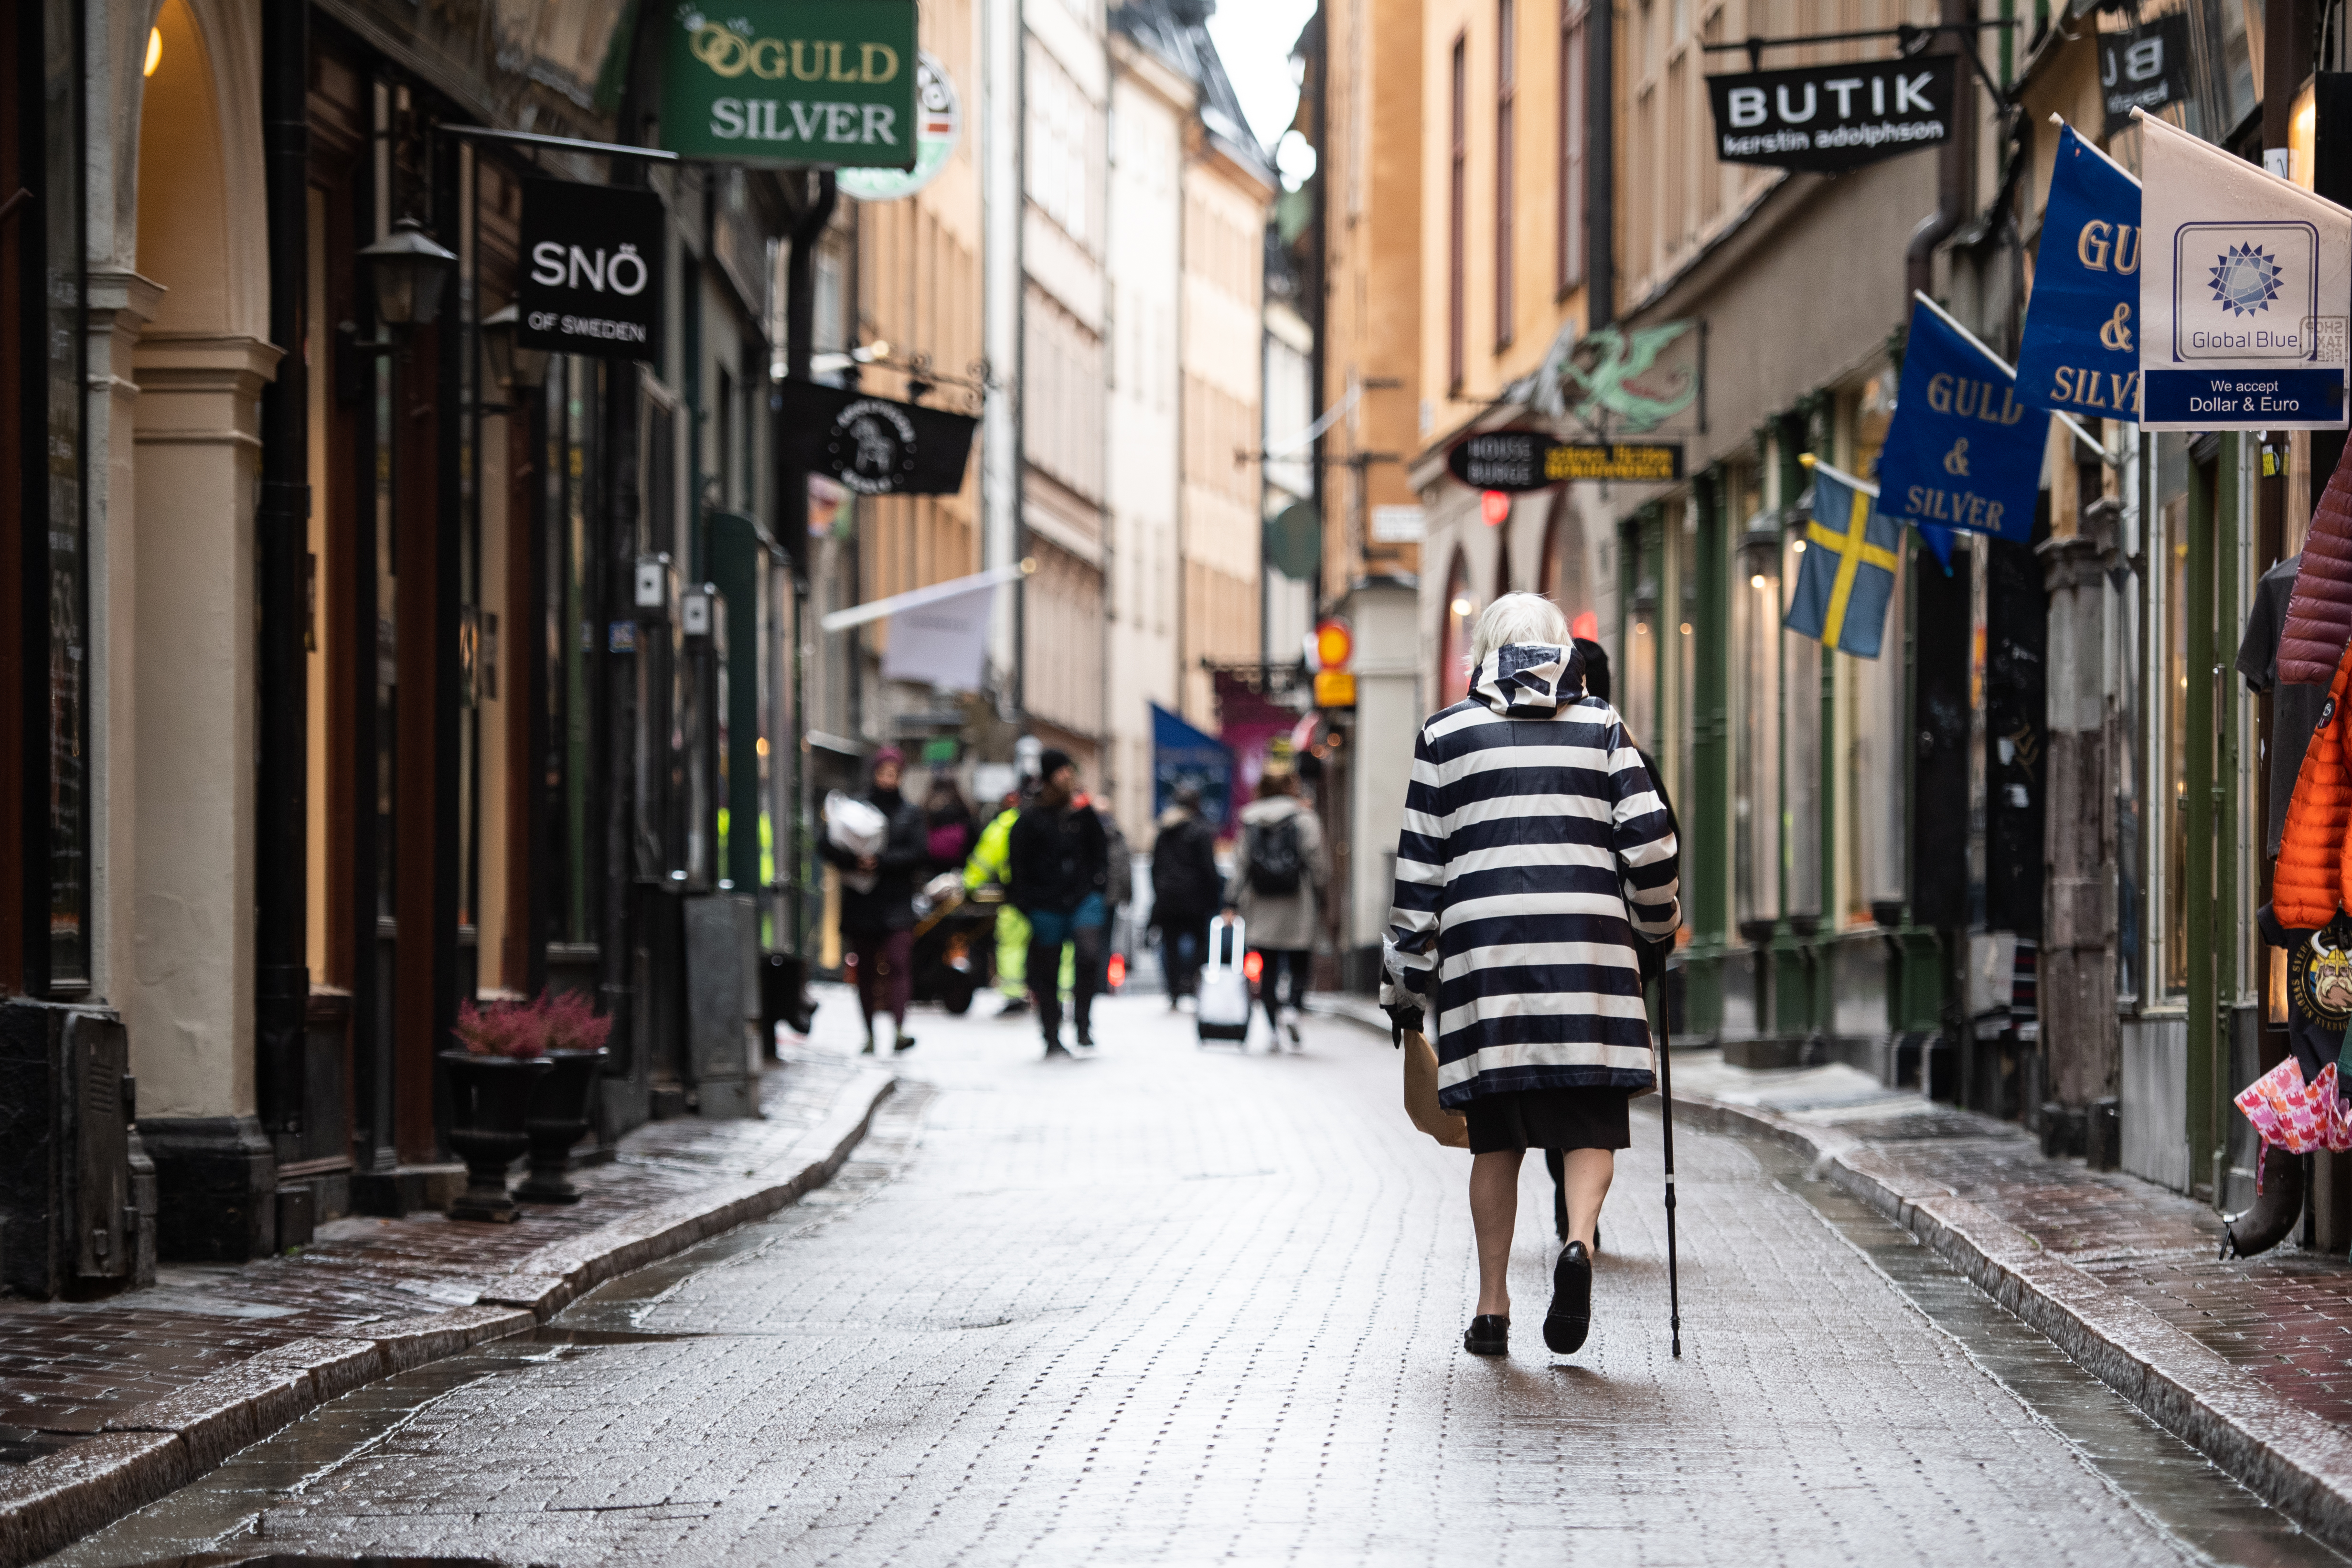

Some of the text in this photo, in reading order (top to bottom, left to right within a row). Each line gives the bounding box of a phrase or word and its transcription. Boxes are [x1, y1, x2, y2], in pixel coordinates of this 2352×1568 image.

[750, 38, 899, 84] GULD
[710, 97, 898, 145] SILVER
[1728, 71, 1935, 128] BUTIK
[531, 242, 648, 296] SNÖ
[2077, 219, 2140, 276] GU
[528, 311, 646, 342] OF SWEDEN
[2099, 302, 2134, 353] &
[2193, 331, 2298, 348] Global Blue
[2190, 397, 2299, 412] Dollar & Euro
[2211, 381, 2278, 394] We accept
[1944, 437, 1971, 476] &
[1904, 485, 2004, 532] SILVER
